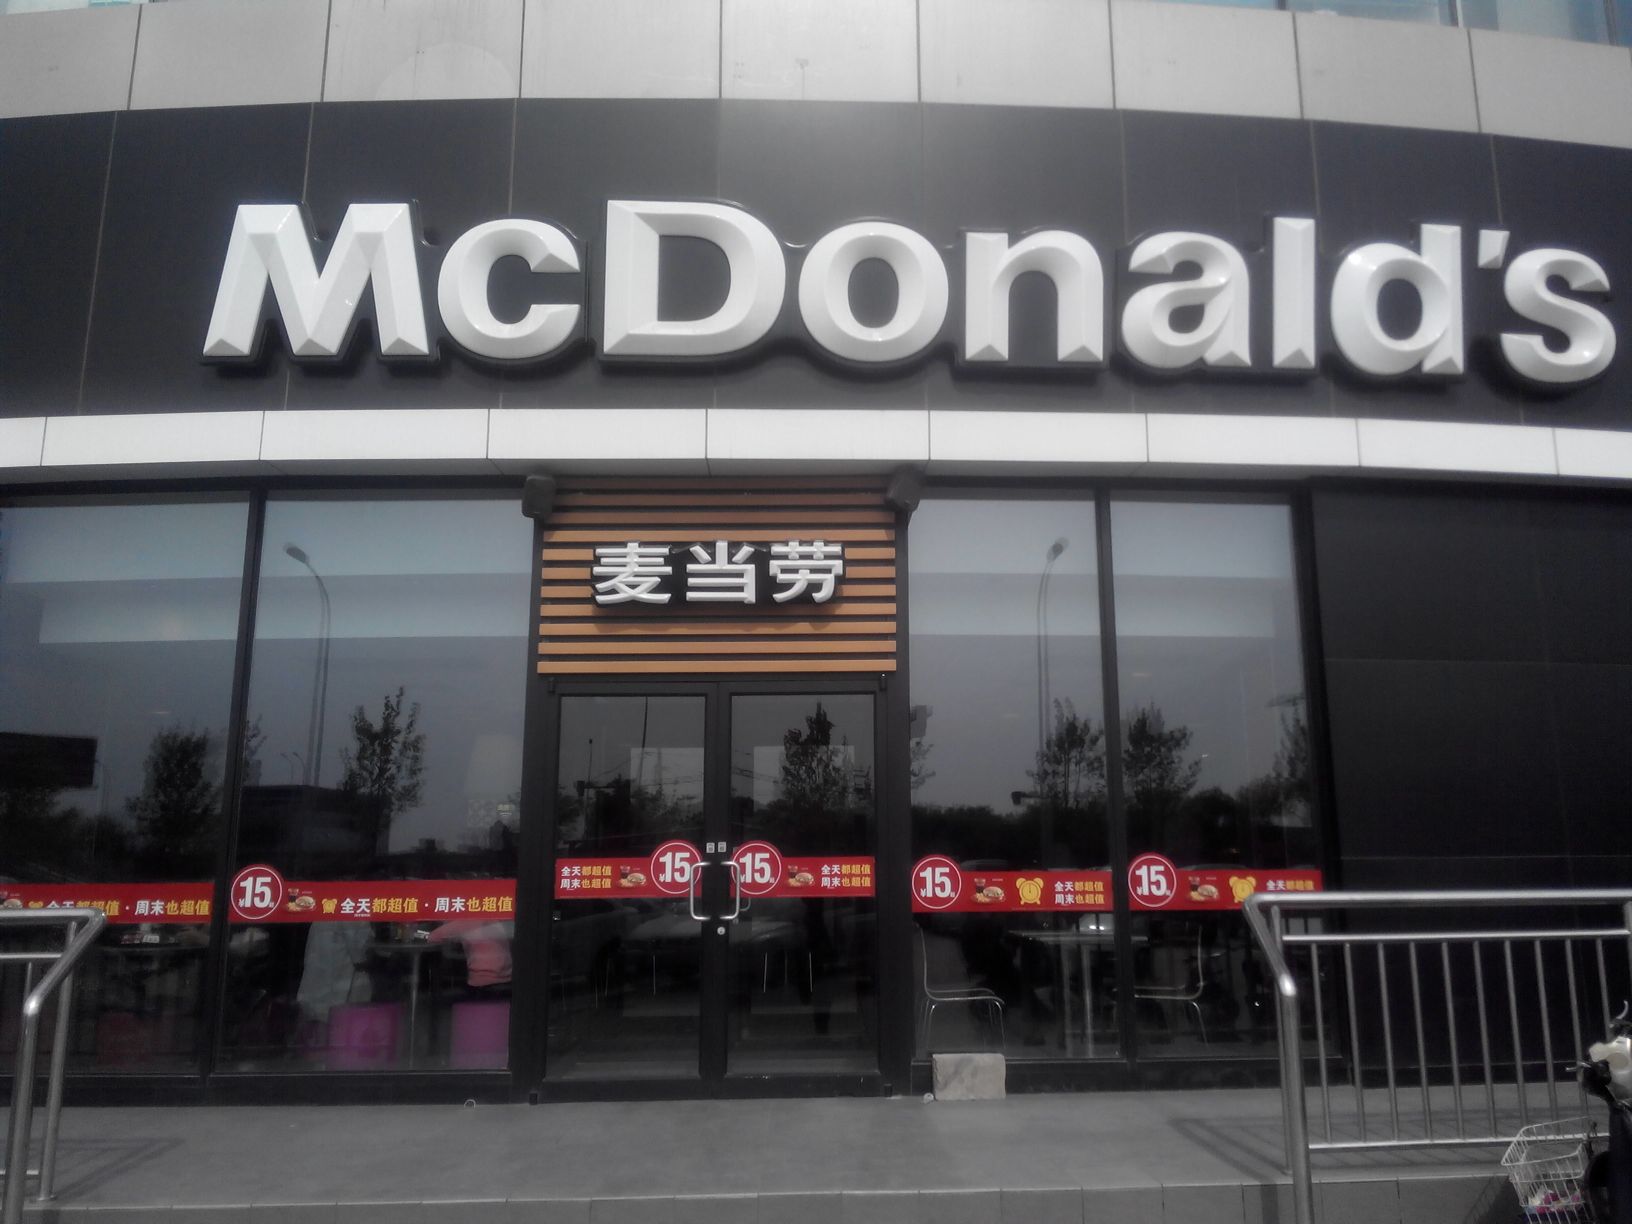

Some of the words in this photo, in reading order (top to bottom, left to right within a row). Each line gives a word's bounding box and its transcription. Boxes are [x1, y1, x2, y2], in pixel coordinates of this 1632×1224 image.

[202, 199, 1617, 383] McDonald's
[593, 540, 843, 604] 麦当劳
[561, 865, 612, 877] 全天都超值
[821, 864, 871, 875] 全天都超值
